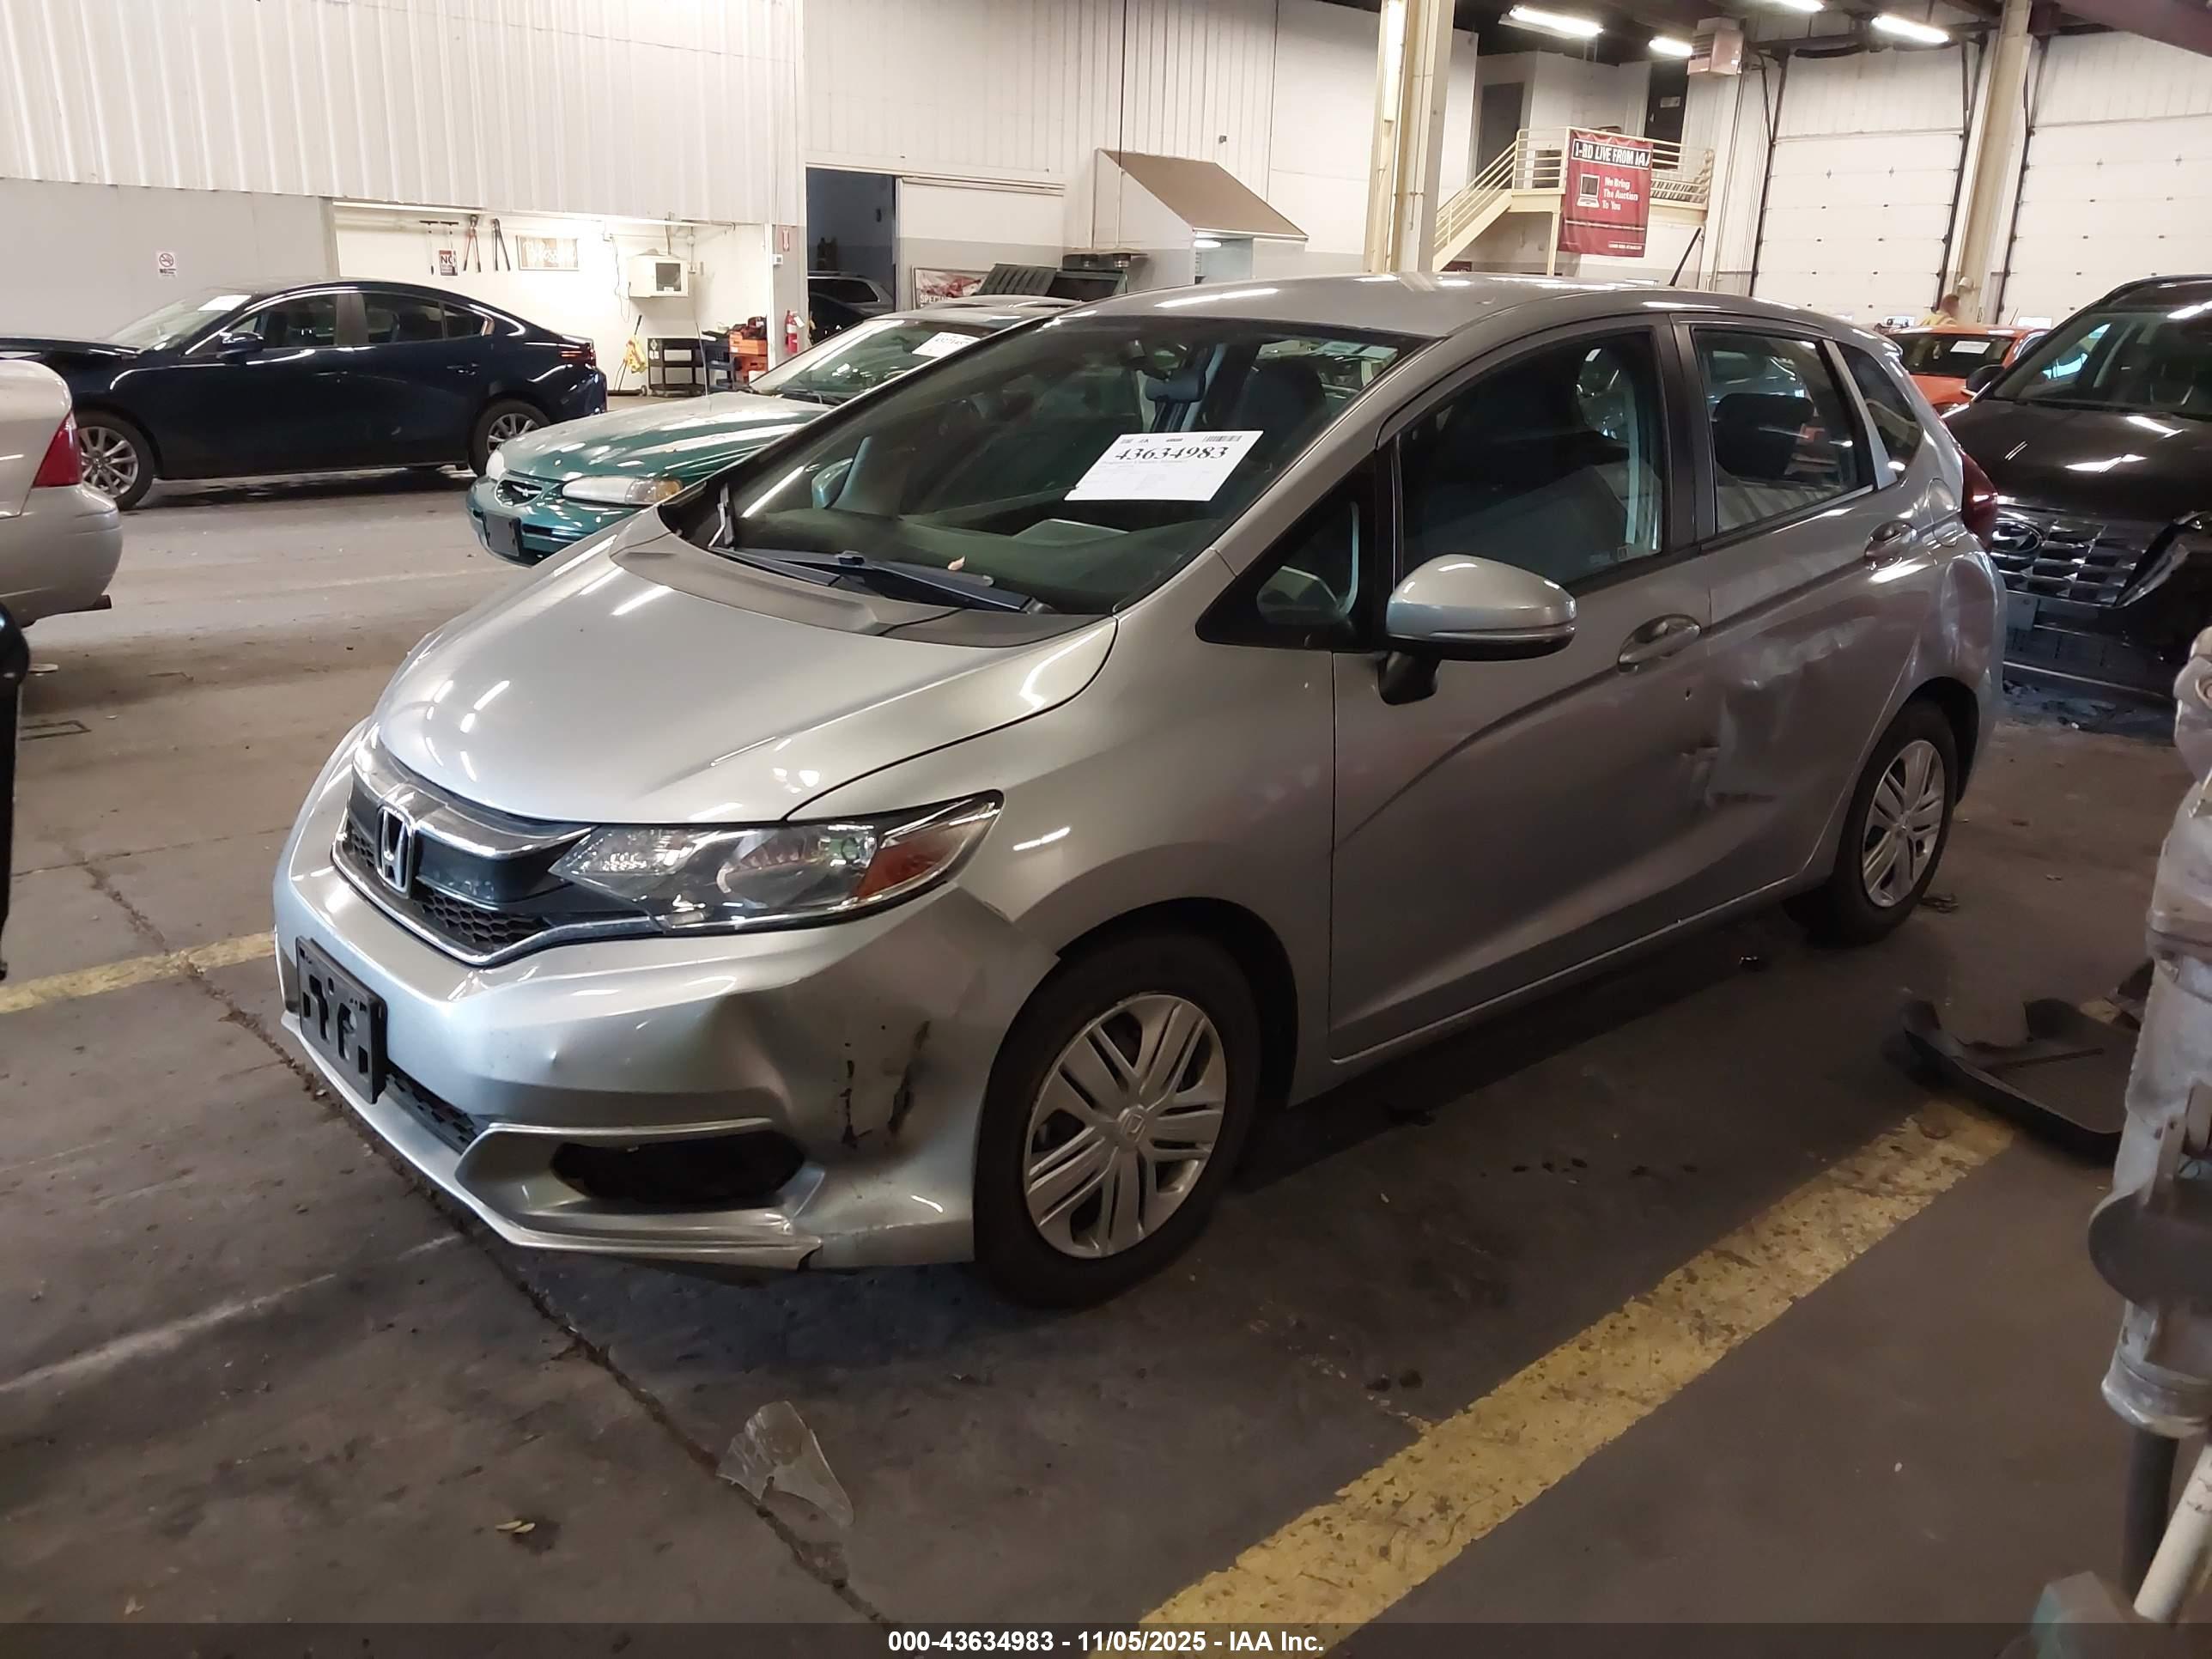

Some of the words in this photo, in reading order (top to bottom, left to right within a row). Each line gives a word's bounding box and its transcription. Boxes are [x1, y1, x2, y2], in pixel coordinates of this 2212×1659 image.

[1595, 146, 1612, 161] LIVE
[1613, 149, 1633, 164] FROM
[1613, 178, 1631, 190] Bring
[1603, 188, 1614, 198] The
[1614, 189, 1638, 201] Auction
[1601, 199, 1609, 210] To
[1610, 200, 1621, 210] You
[1115, 446, 1229, 460] 43634983
